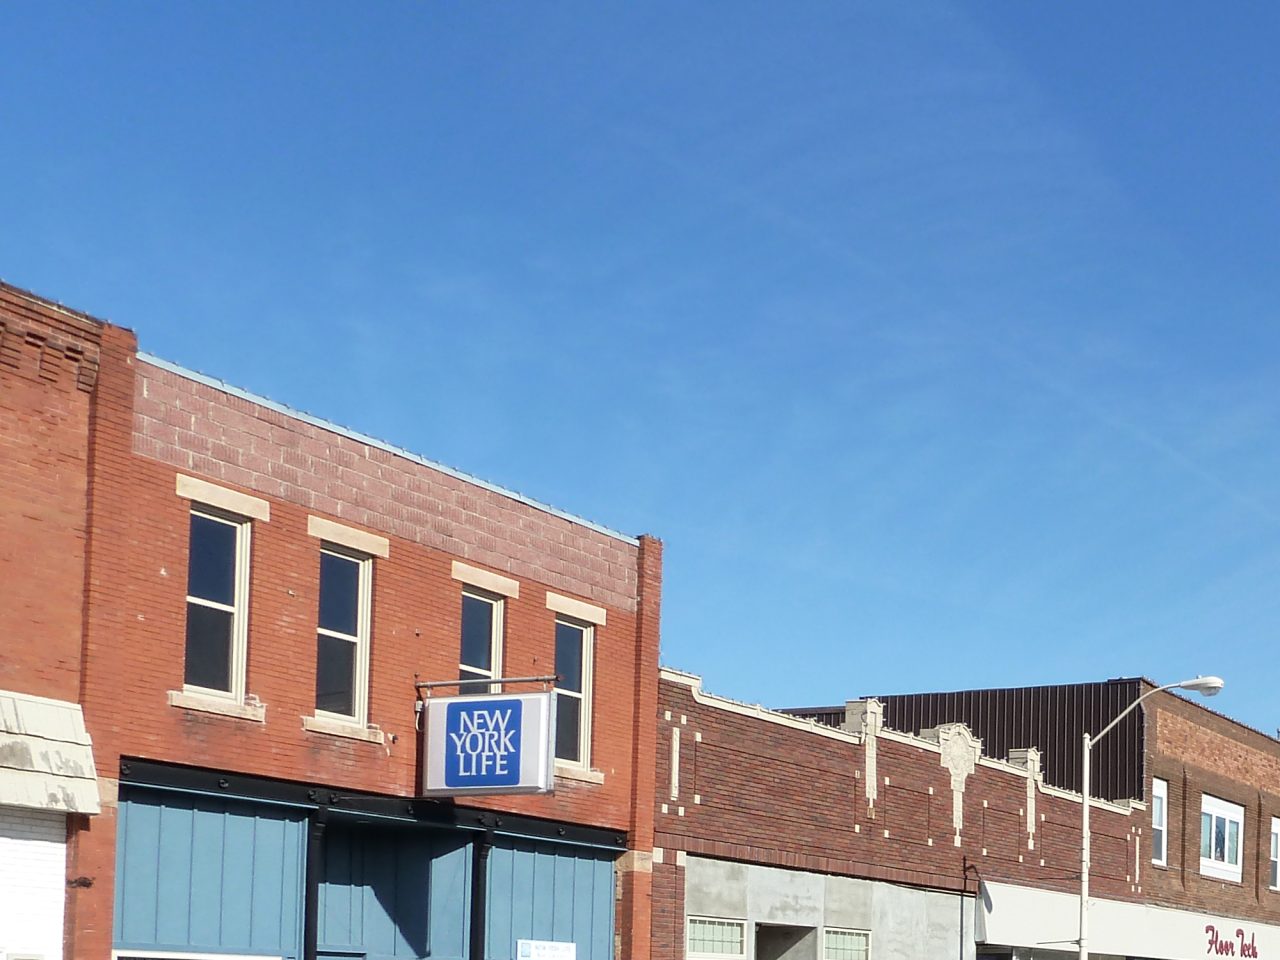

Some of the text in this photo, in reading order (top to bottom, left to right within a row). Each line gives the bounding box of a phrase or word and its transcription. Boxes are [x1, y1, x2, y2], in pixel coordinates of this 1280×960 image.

[459, 709, 512, 733] NEW
[449, 729, 516, 755] YORK
[458, 752, 508, 776] LIFE
[1205, 925, 1235, 956] Floor
